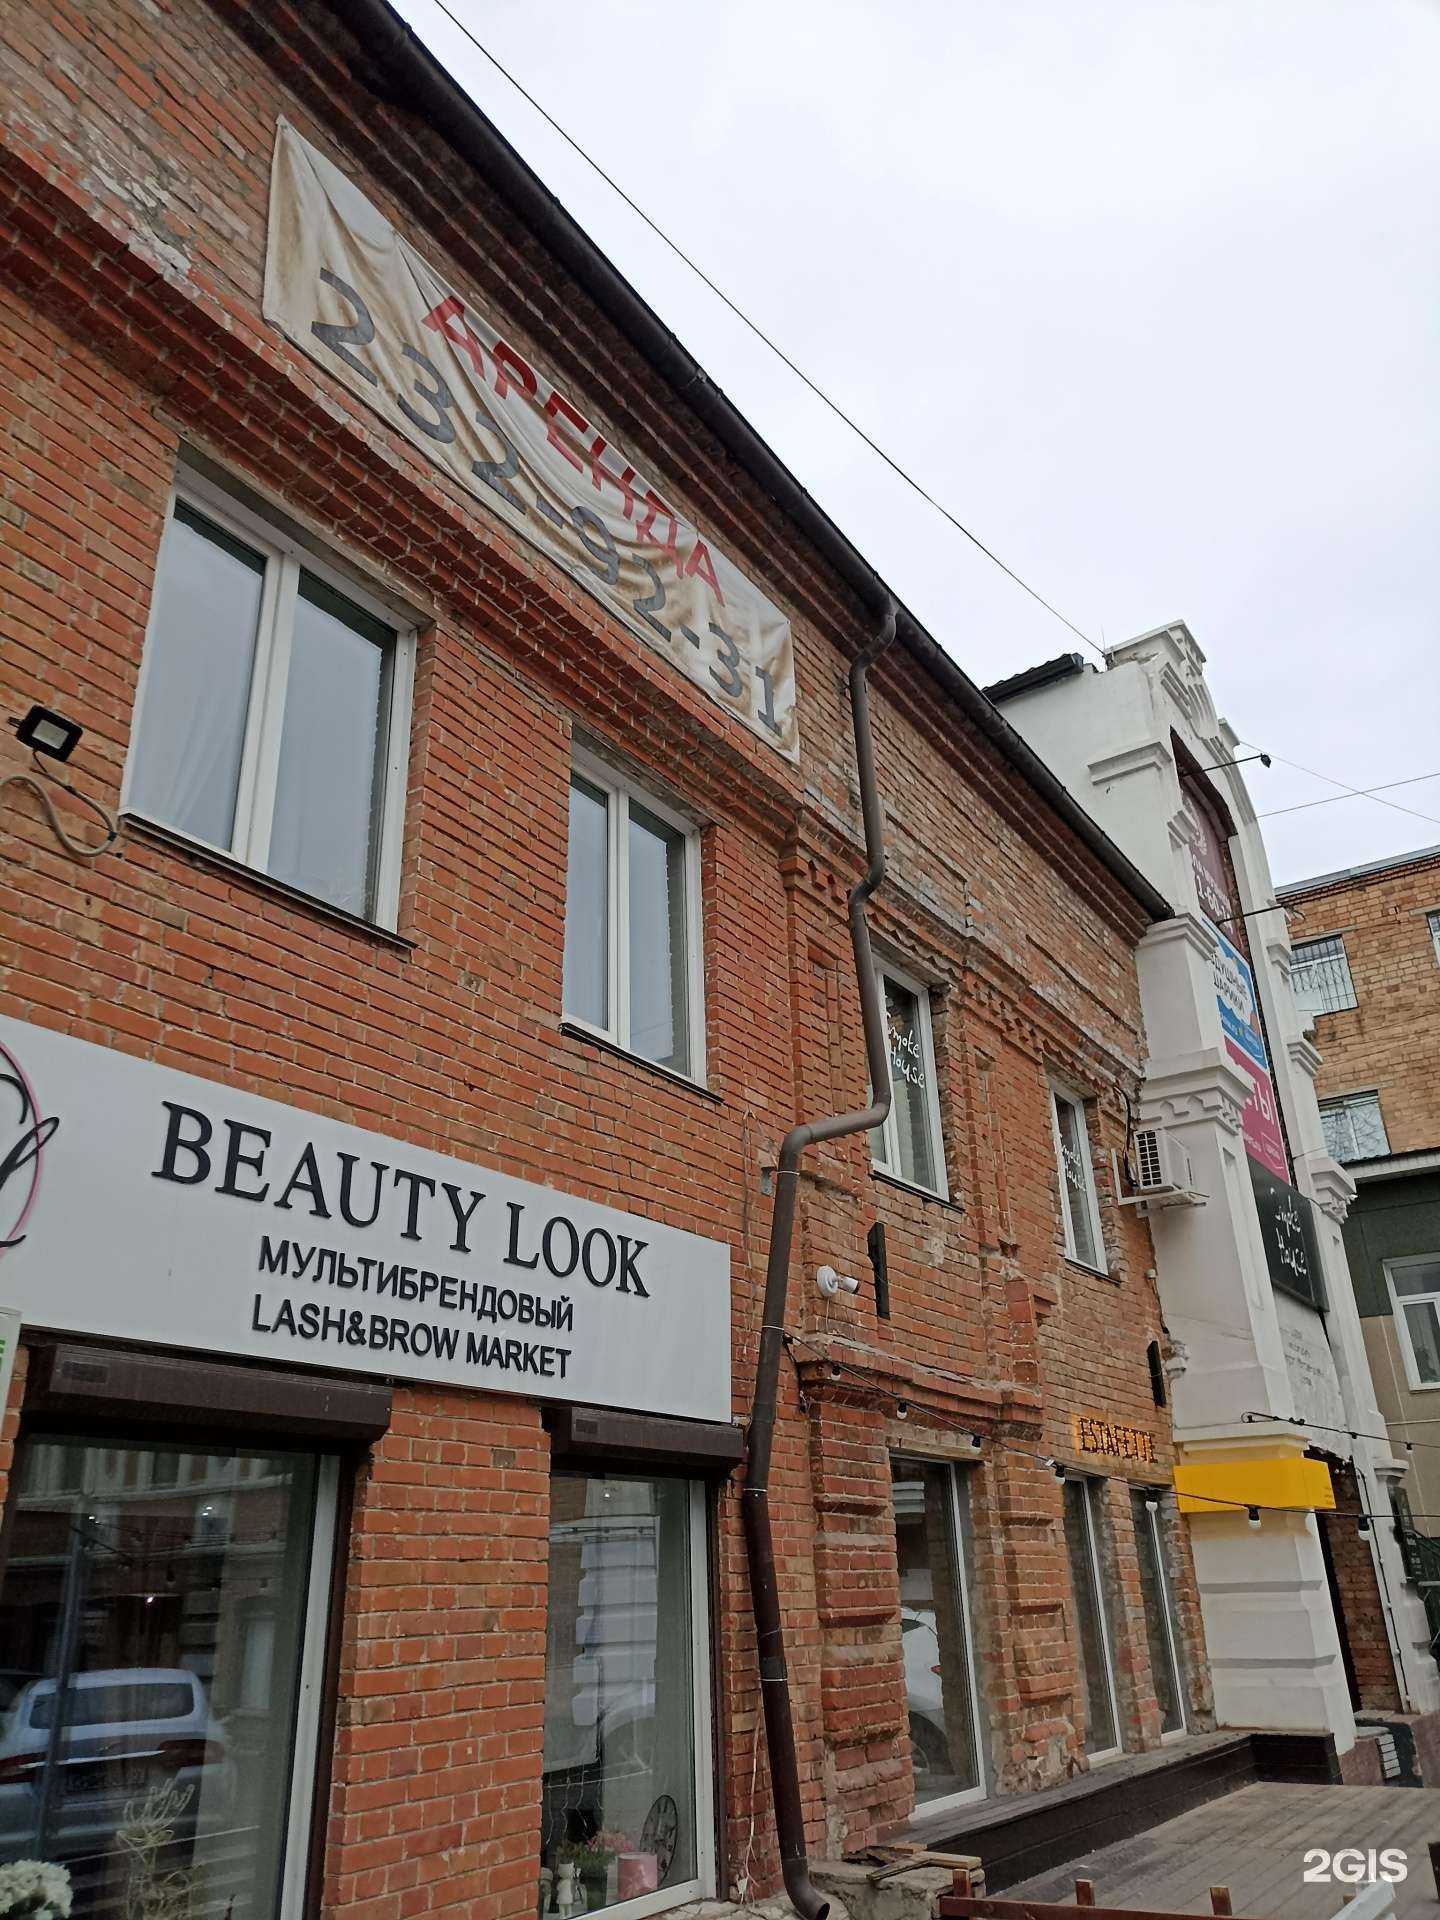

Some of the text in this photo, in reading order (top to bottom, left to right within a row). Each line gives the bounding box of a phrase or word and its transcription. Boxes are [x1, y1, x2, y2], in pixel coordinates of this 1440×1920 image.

[310, 267, 783, 738] 232-92-31
[422, 295, 726, 607] АРЕНДА
[151, 1100, 486, 1254] BEAUTY
[503, 1201, 652, 1299] LOOK
[258, 1235, 575, 1332] МУЛЬТИБРЕНДОВЫЙ
[252, 1293, 573, 1380] LASH&BROW MARKET
